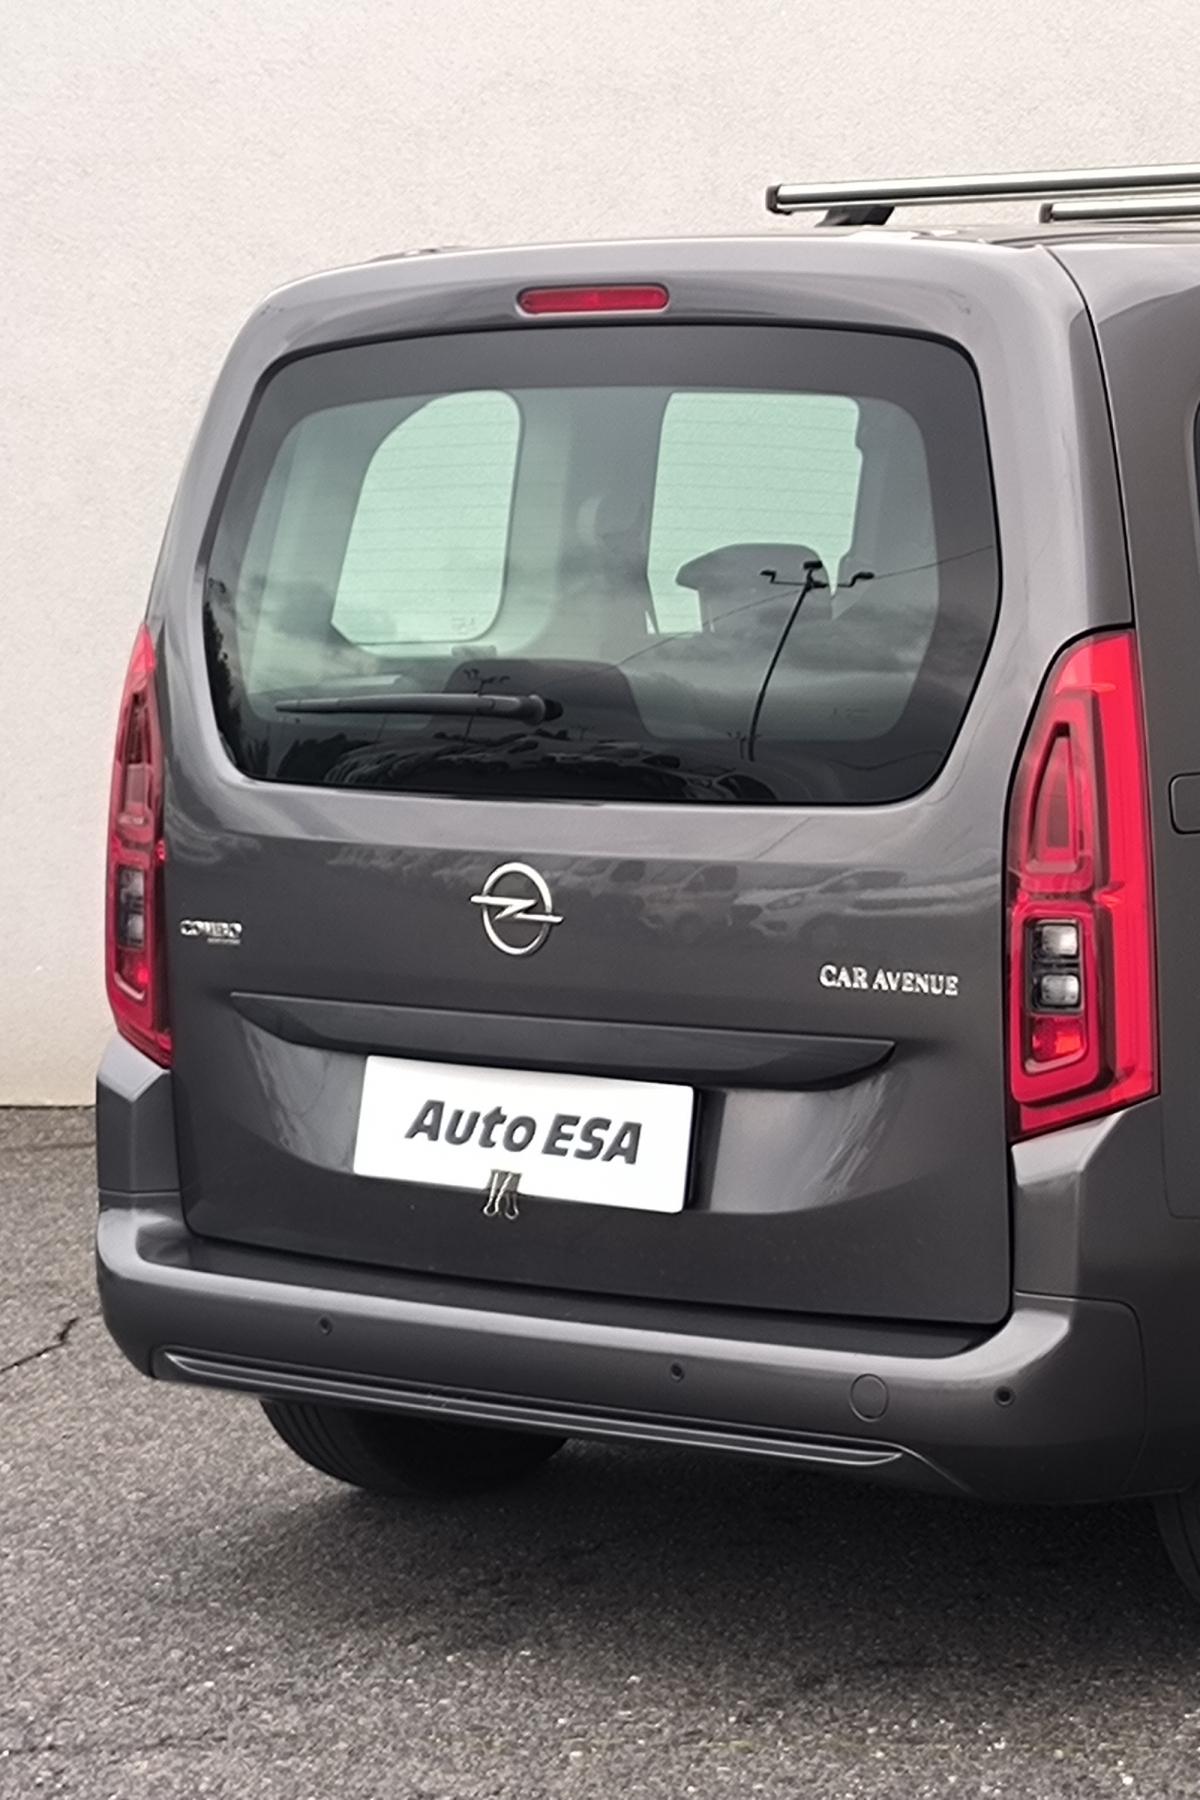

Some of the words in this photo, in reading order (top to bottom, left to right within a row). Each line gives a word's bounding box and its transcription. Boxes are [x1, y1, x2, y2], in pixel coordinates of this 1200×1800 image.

[819, 964, 868, 990] CAR
[872, 968, 959, 996] AVENUE
[404, 1099, 537, 1153] Auto
[541, 1113, 643, 1165] ESA
